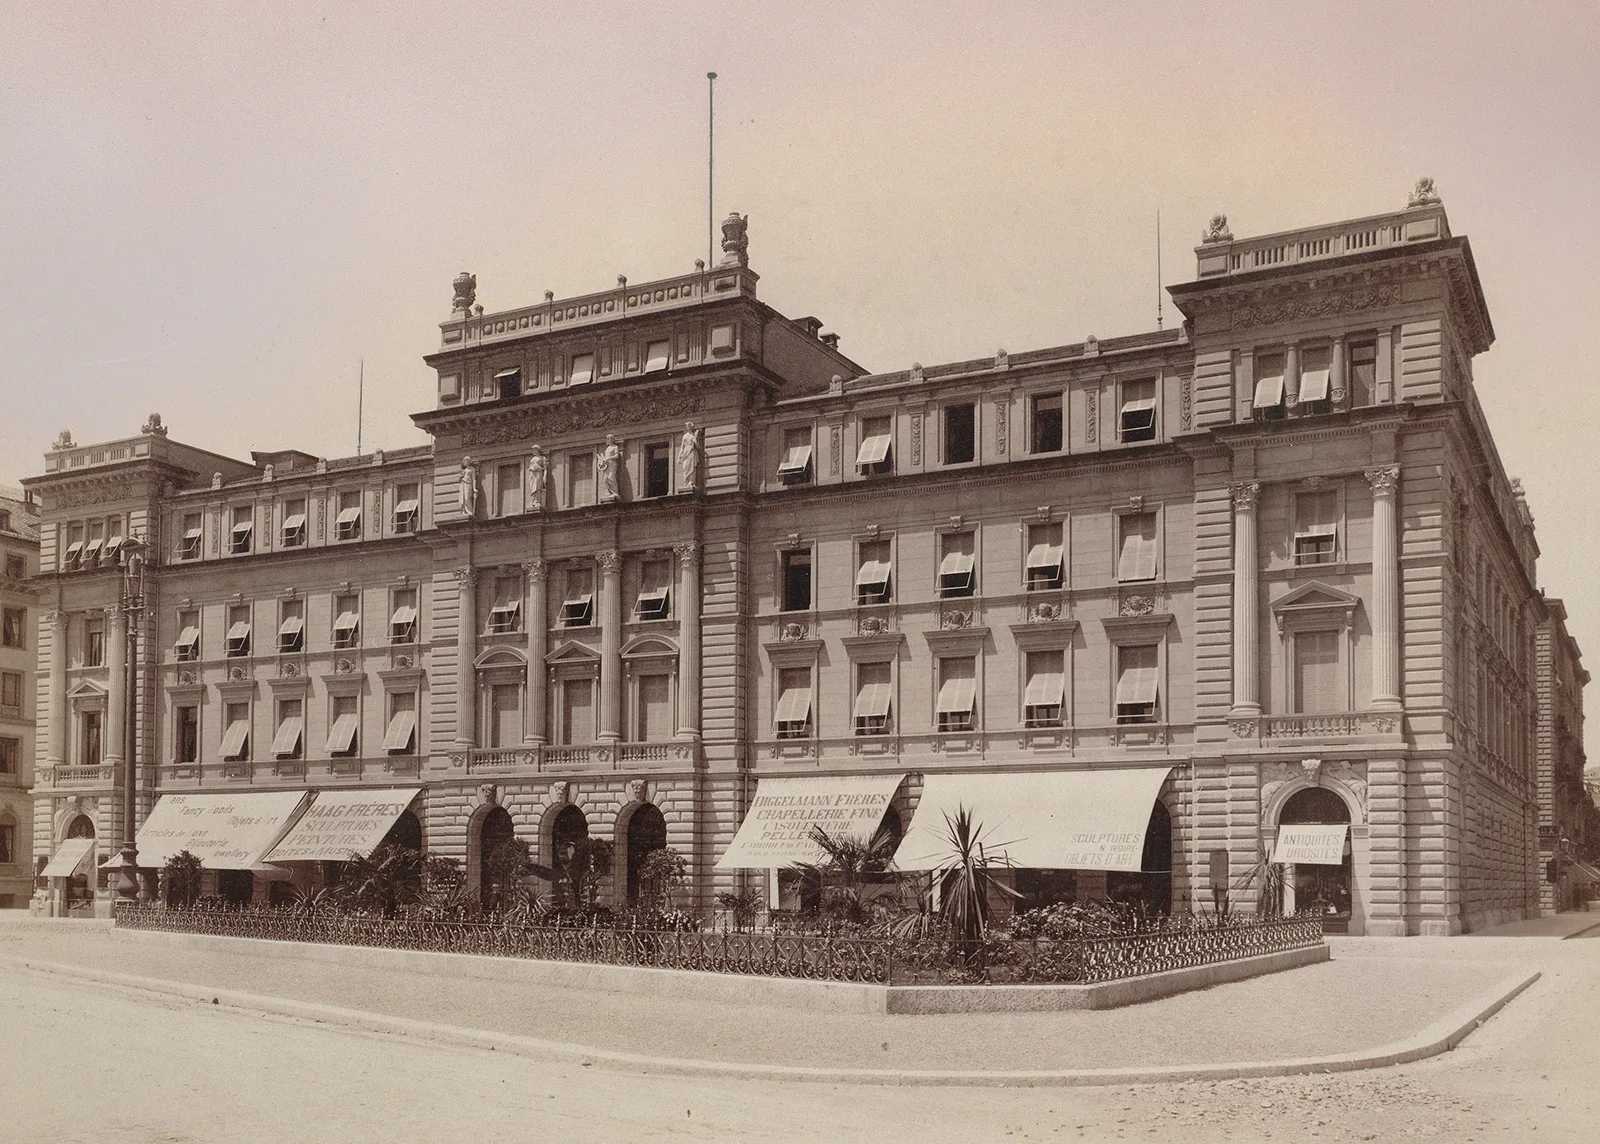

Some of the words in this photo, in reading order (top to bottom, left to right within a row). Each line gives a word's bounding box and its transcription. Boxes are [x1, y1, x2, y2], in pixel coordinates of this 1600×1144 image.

[754, 795, 834, 807] DIGGELMANN
[180, 806, 205, 817] Fancy
[305, 804, 346, 817] HAAG
[756, 809, 848, 820] CHAPELLERIE
[849, 808, 882, 819] FINE
[227, 816, 255, 828] Objets
[301, 819, 382, 832] SCULPTURES
[185, 838, 228, 848] Bijouterie
[287, 834, 370, 845] PEINTURES
[1071, 833, 1140, 843] SCULPTURES
